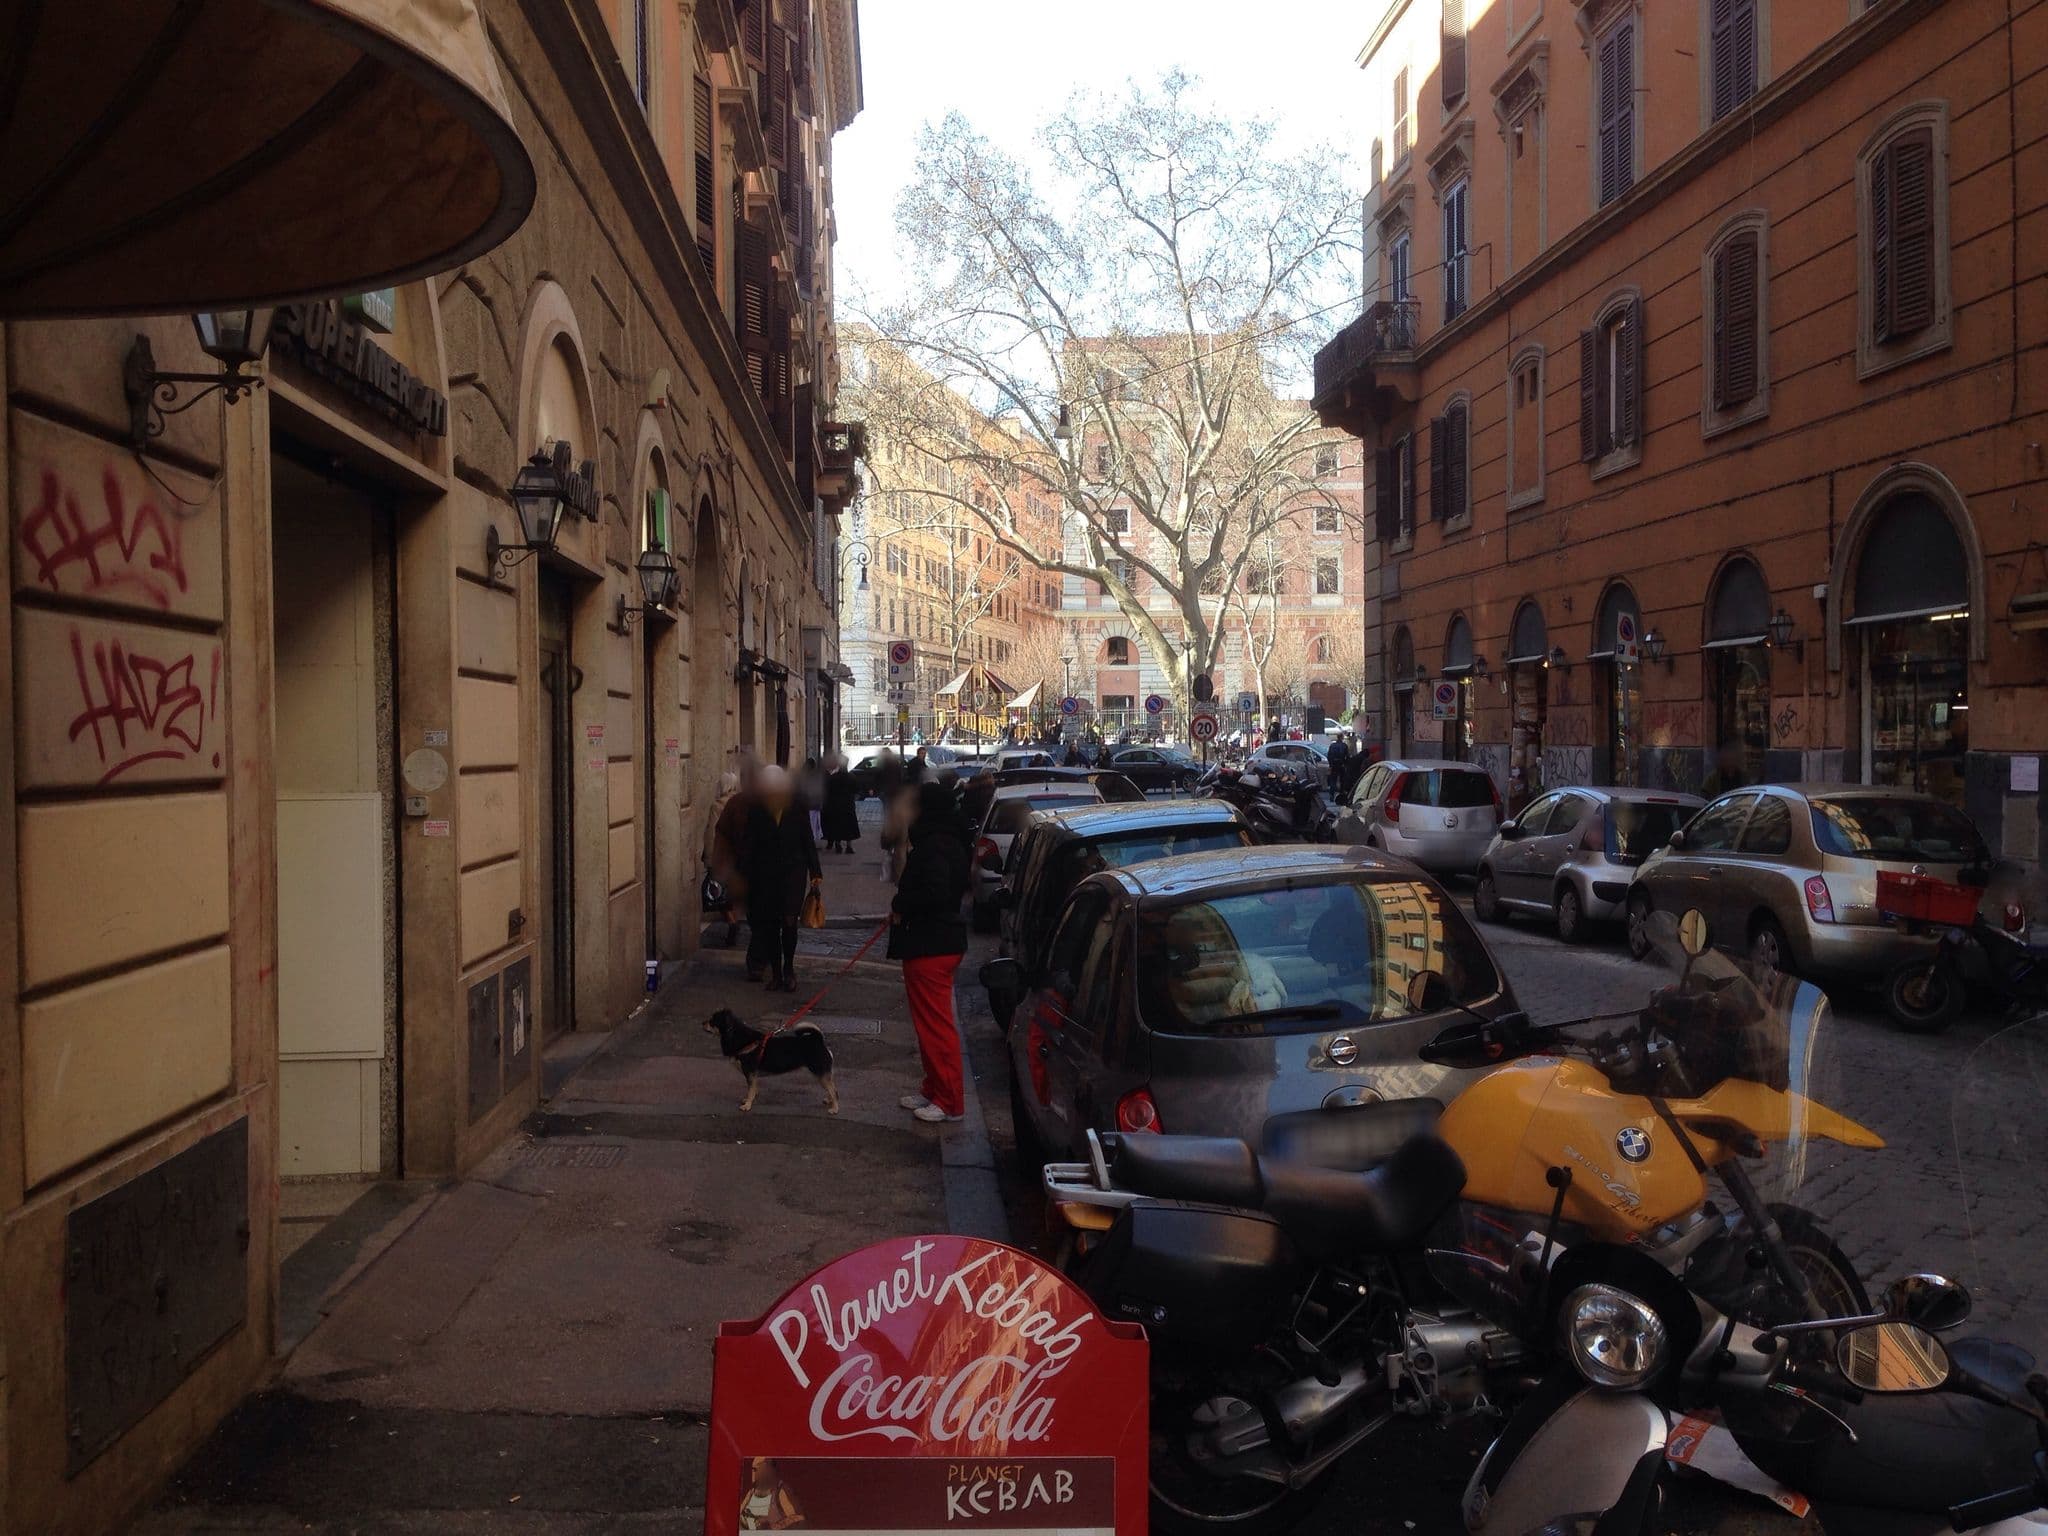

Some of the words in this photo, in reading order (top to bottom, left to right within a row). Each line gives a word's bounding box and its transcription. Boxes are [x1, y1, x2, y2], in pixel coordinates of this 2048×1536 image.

[1197, 722, 1212, 735] 20
[768, 1238, 936, 1389] Planet
[947, 1463, 1025, 1483] PLANET
[945, 1469, 1075, 1521] KEBAB
